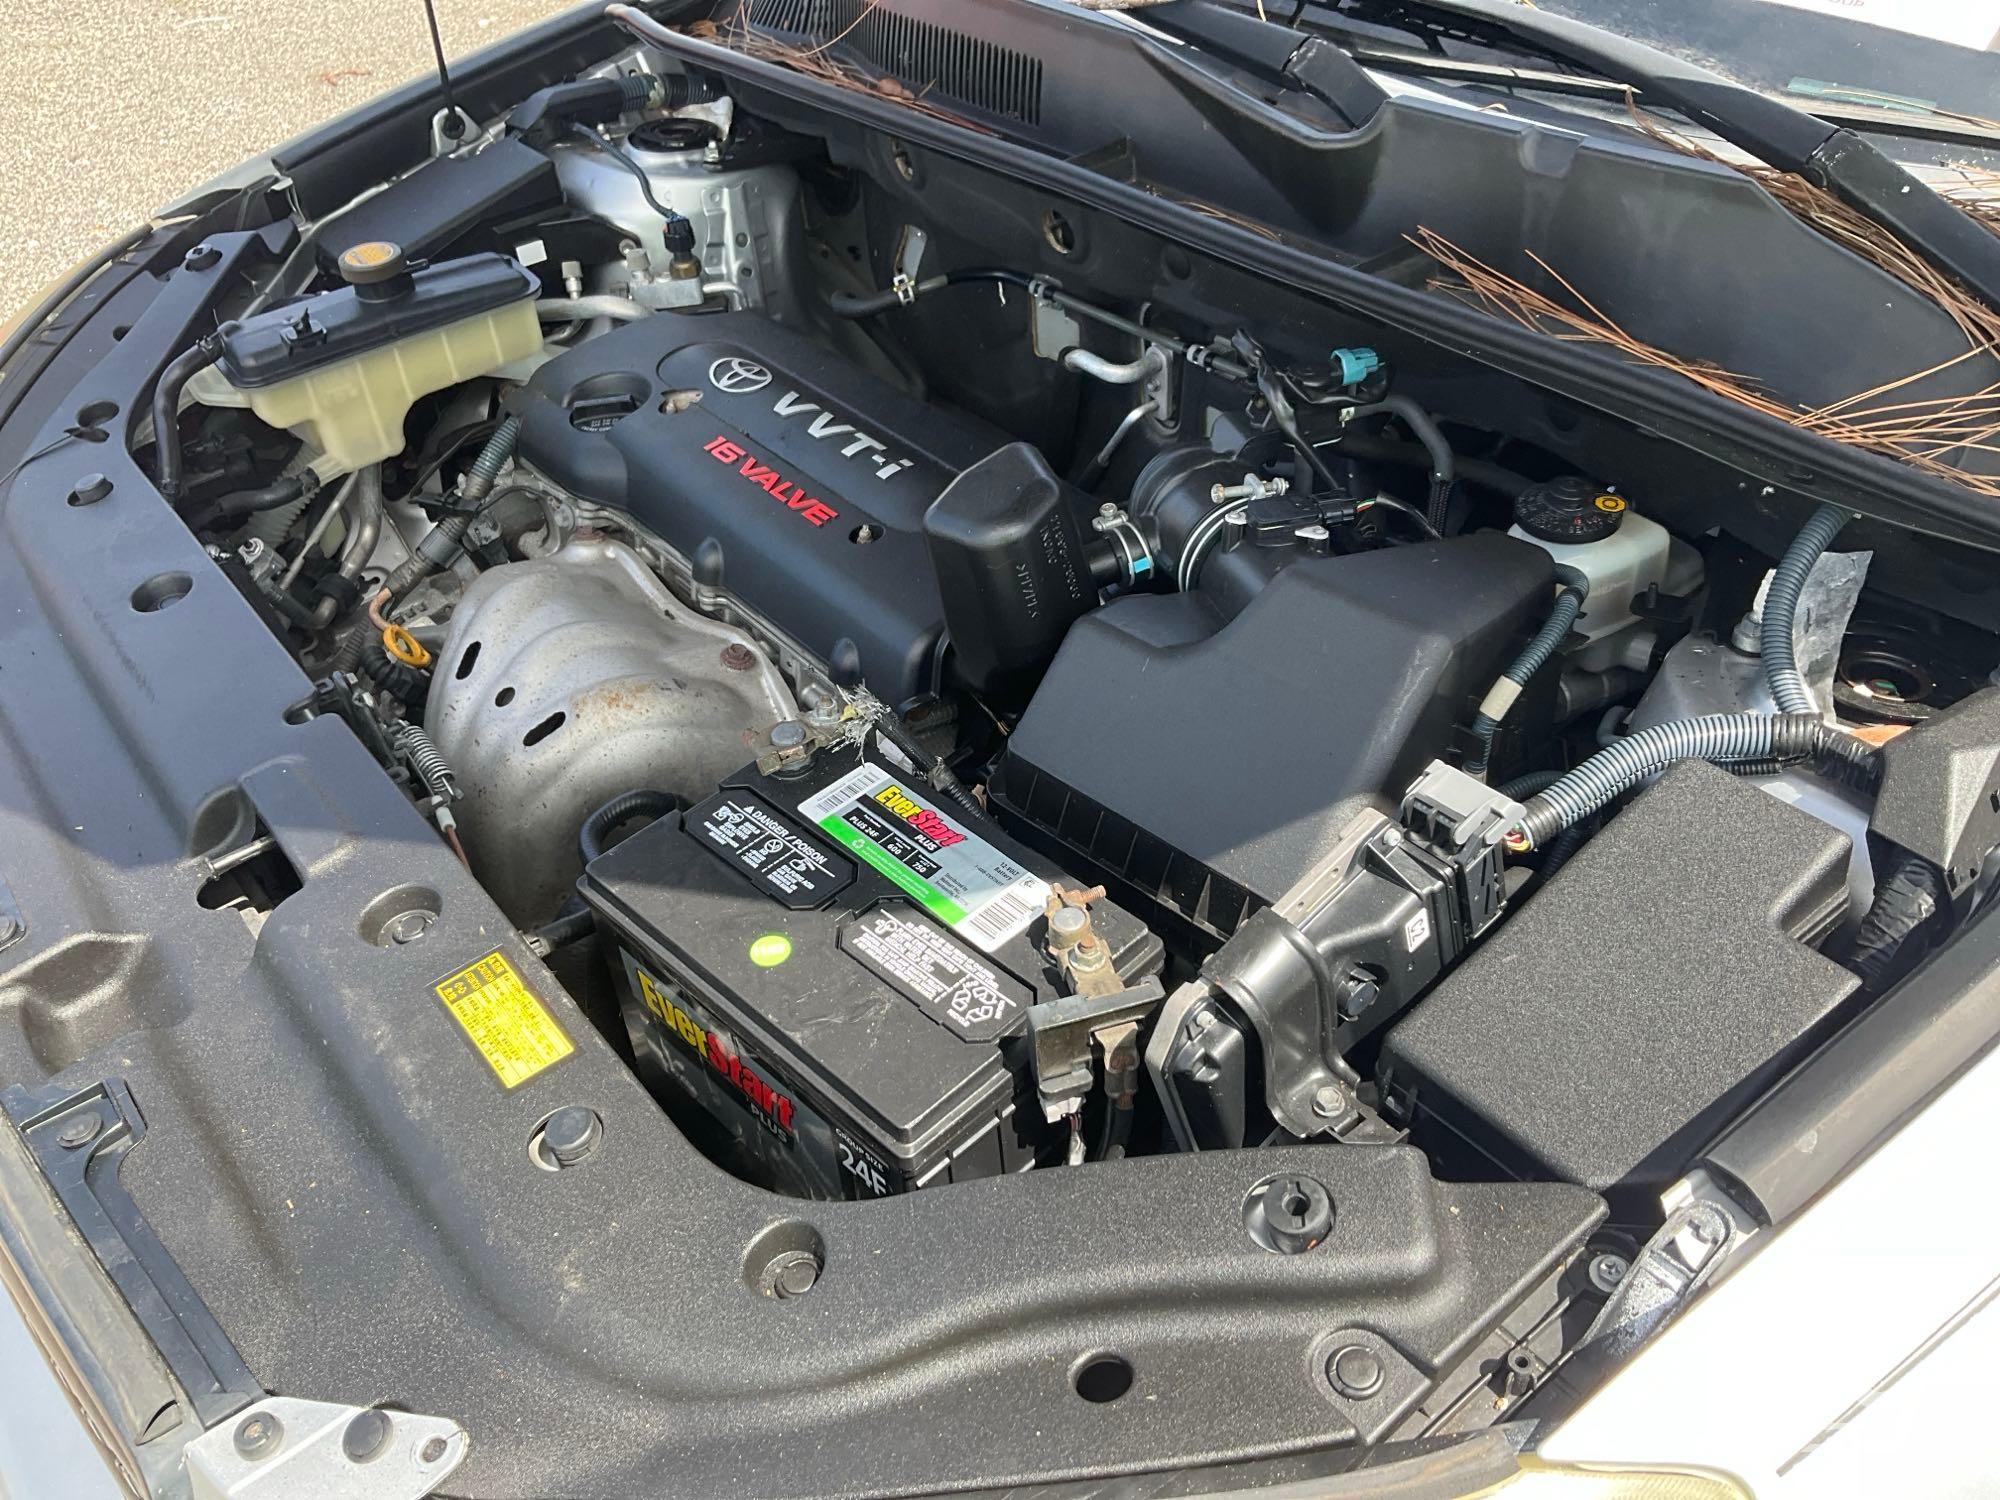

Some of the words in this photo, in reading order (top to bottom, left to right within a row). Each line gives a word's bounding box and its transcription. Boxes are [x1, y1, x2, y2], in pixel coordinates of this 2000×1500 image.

[772, 391, 915, 480] VVT-i
[703, 435, 747, 464] 16
[738, 457, 839, 527] VALVE
[751, 811, 788, 838] DANGER
[791, 836, 828, 865] POISON
[849, 815, 868, 832] PLUS
[864, 826, 879, 838] 24F
[874, 785, 966, 847] EverStart
[887, 843, 902, 855] 600
[914, 834, 938, 851] PLUS
[912, 861, 927, 874] 750
[637, 969, 796, 1134] EverStart
[751, 1106, 789, 1143] PLUS
[835, 1128, 865, 1154] GROUP
[865, 1152, 884, 1173] SIZE
[839, 1143, 887, 1196] 24F
